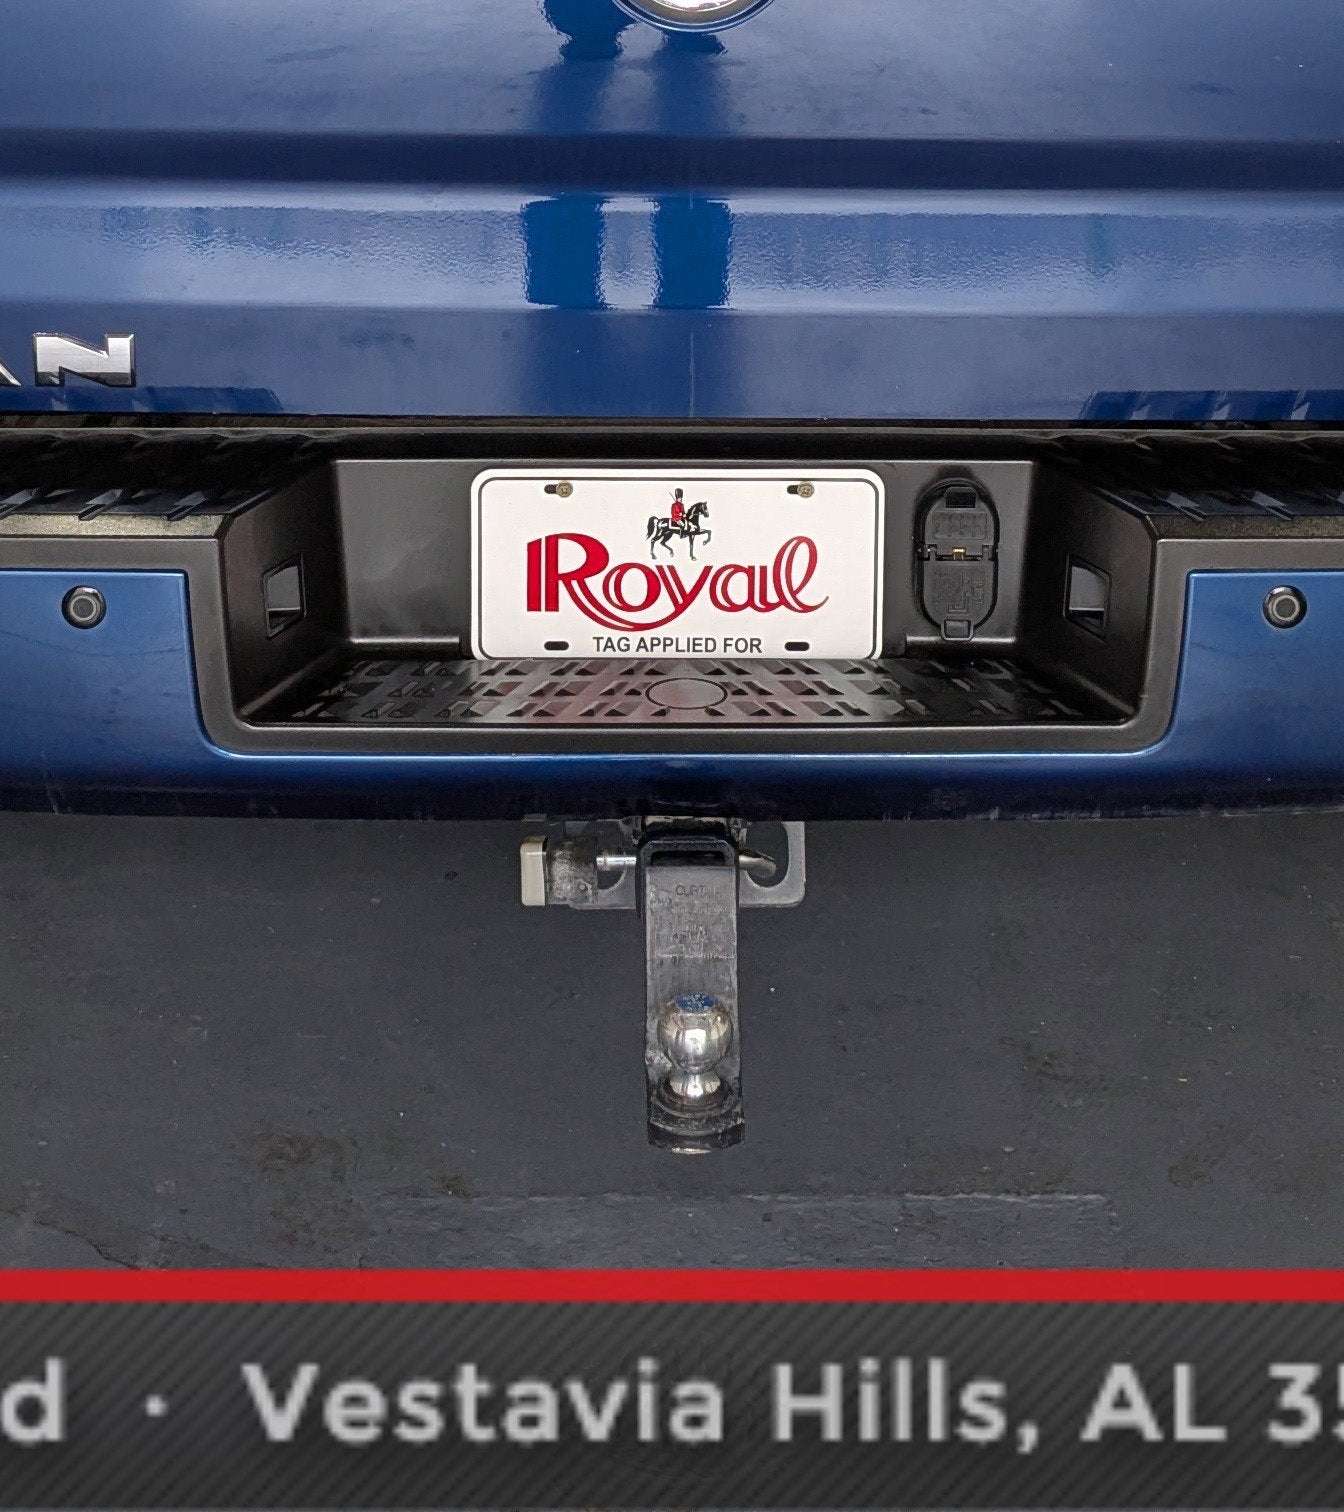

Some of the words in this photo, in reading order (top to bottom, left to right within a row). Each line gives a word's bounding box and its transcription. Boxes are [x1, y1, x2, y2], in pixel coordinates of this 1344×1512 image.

[526, 532, 830, 633] Royal
[592, 636, 630, 654] TAG
[636, 636, 718, 654] APPLIED
[722, 637, 763, 655] FOR
